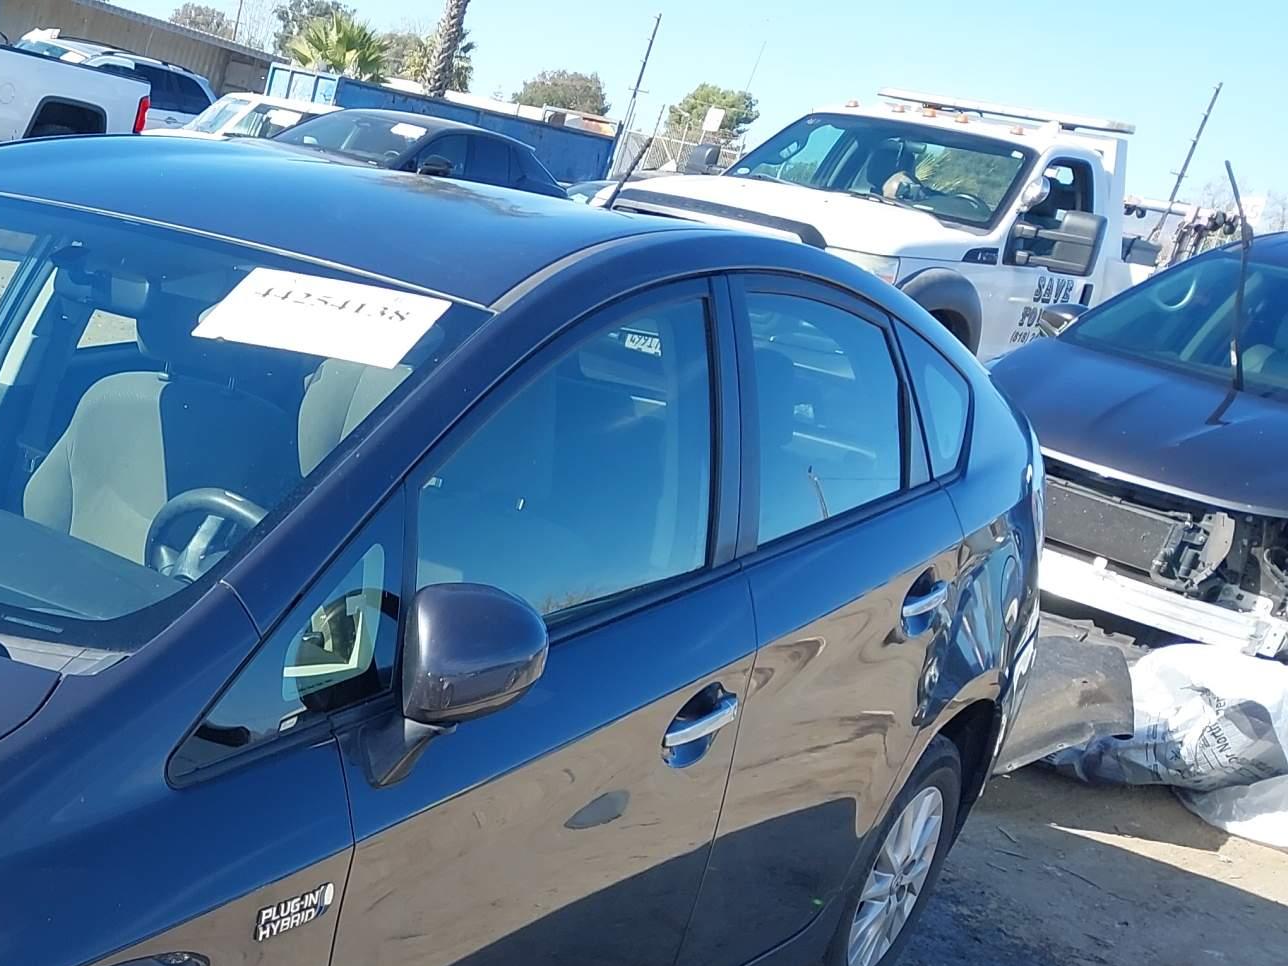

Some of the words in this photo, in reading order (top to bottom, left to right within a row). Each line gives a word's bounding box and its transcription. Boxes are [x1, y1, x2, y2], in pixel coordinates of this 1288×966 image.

[1032, 275, 1075, 303] SAVE
[260, 888, 322, 925] PLUG-IN
[258, 908, 317, 942] HYBRID
